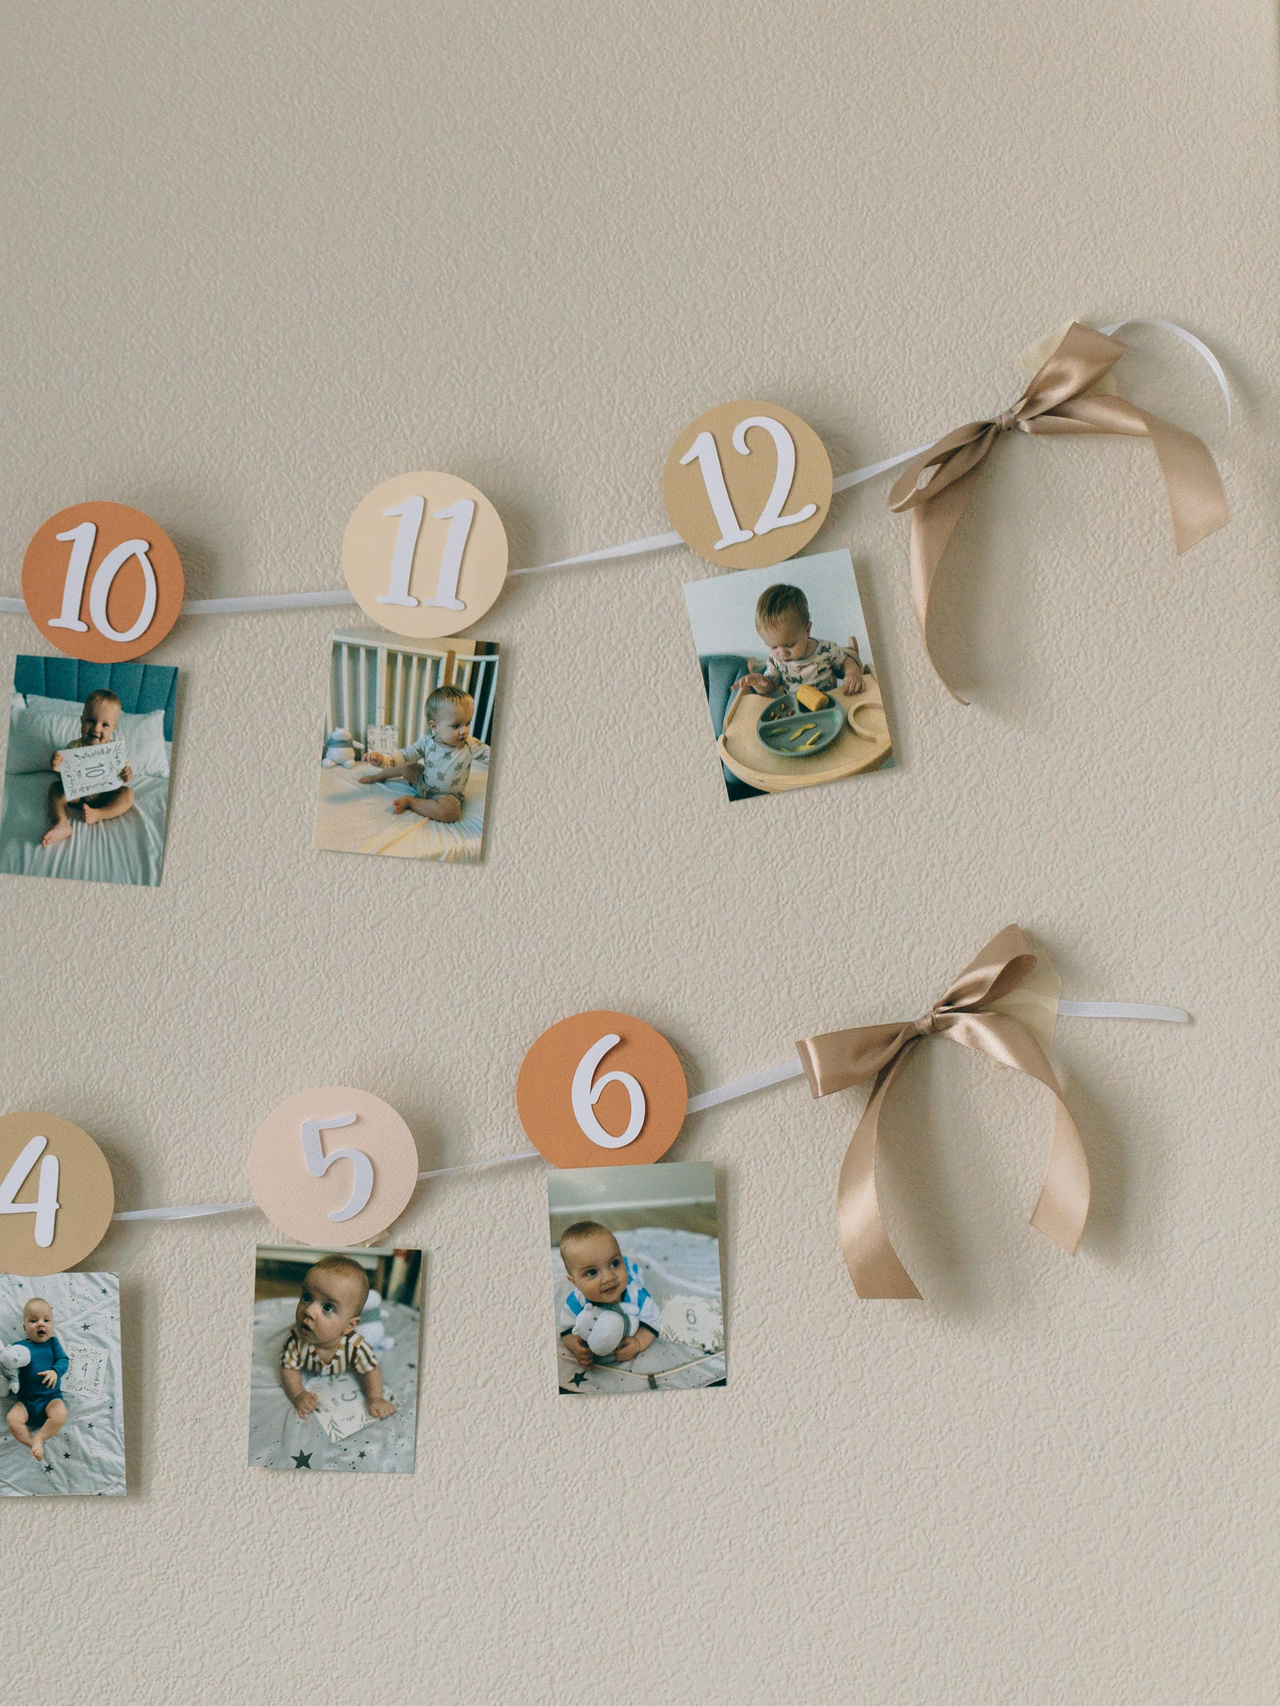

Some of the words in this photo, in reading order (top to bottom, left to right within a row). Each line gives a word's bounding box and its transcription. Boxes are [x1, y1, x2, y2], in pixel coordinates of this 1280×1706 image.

[679, 416, 817, 550] 12
[48, 522, 158, 643] 10
[376, 496, 475, 611] 11
[85, 763, 105, 778] 10
[570, 1034, 646, 1149] 6
[301, 1114, 374, 1222] 5
[81, 1362, 89, 1378] 4
[686, 1308, 697, 1325] 6
